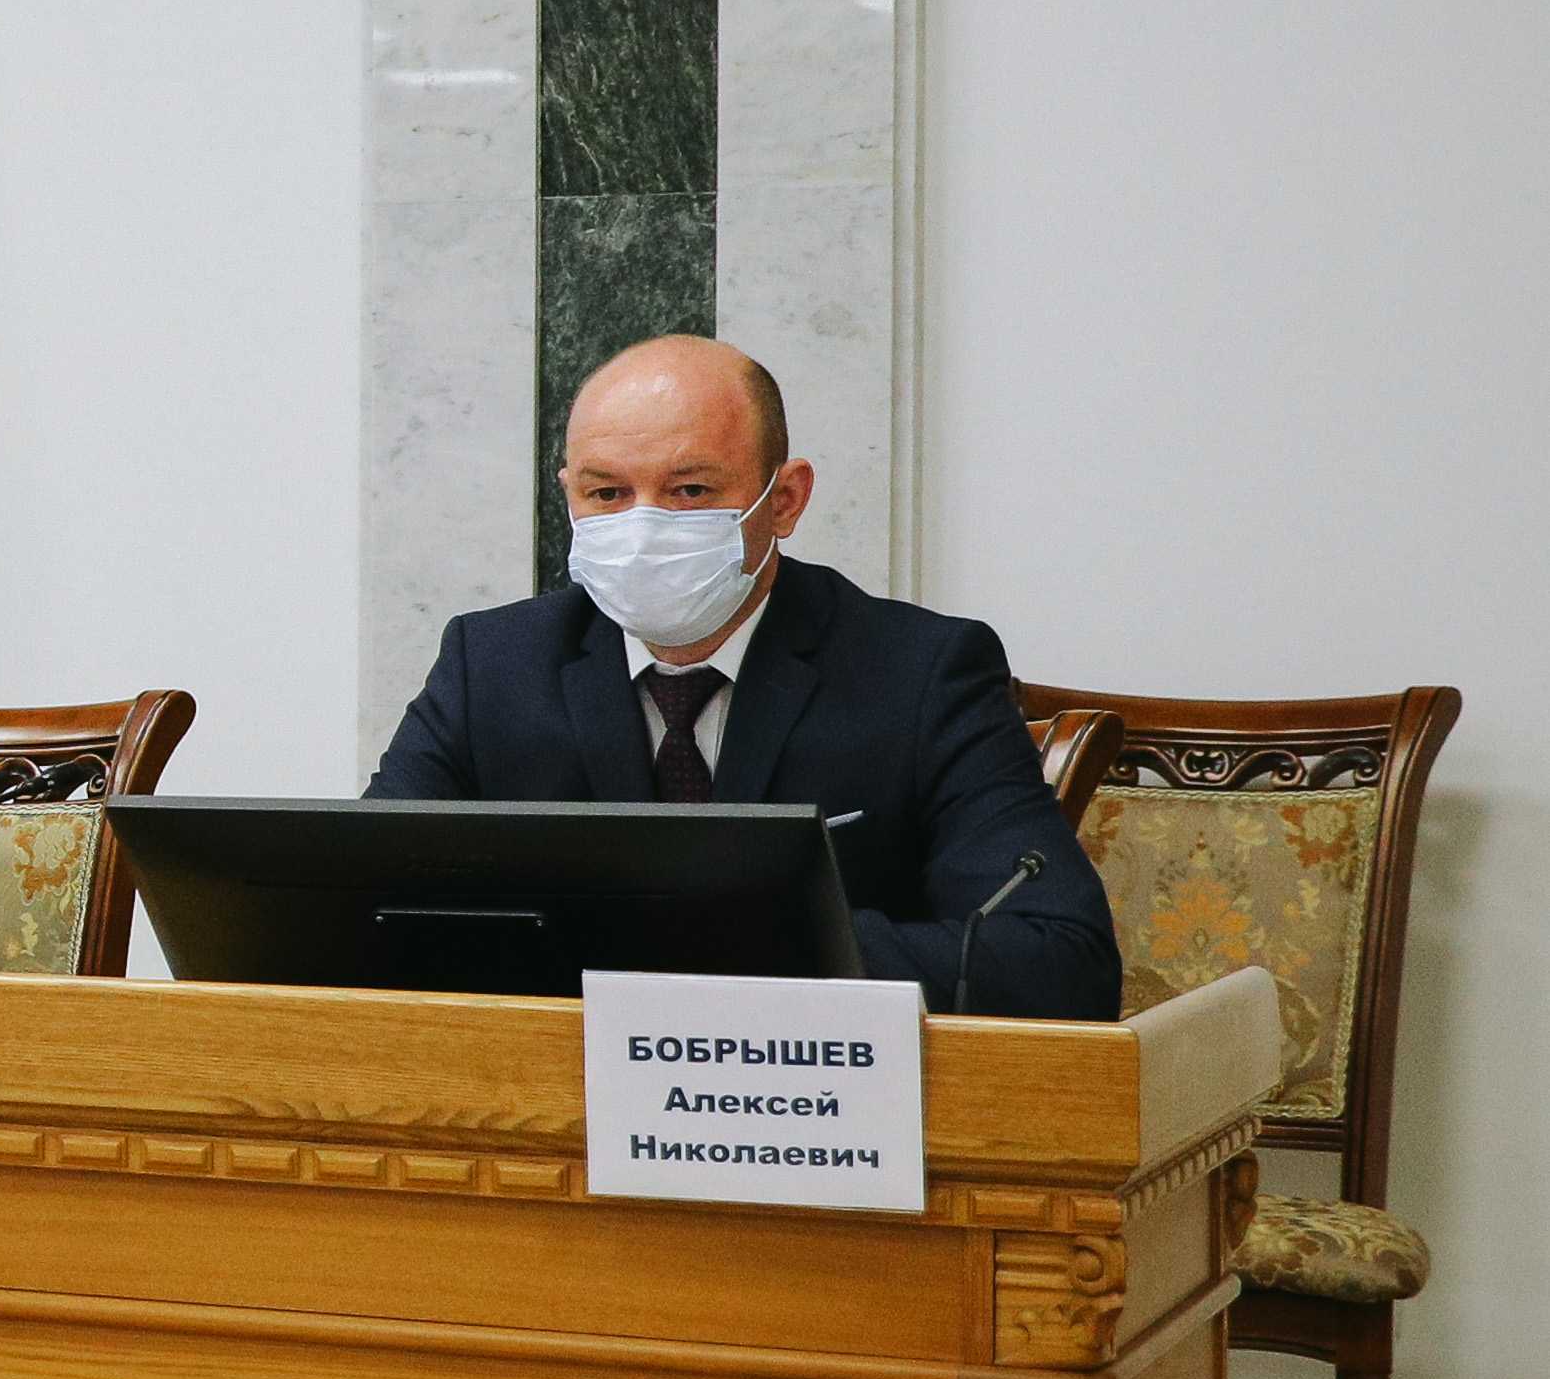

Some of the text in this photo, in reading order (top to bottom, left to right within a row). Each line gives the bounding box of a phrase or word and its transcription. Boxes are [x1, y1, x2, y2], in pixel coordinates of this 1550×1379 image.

[627, 1035, 875, 1068] БОБРЫШЕВ
[663, 1087, 840, 1117] Алексей
[629, 1134, 880, 1169] Николаевич
